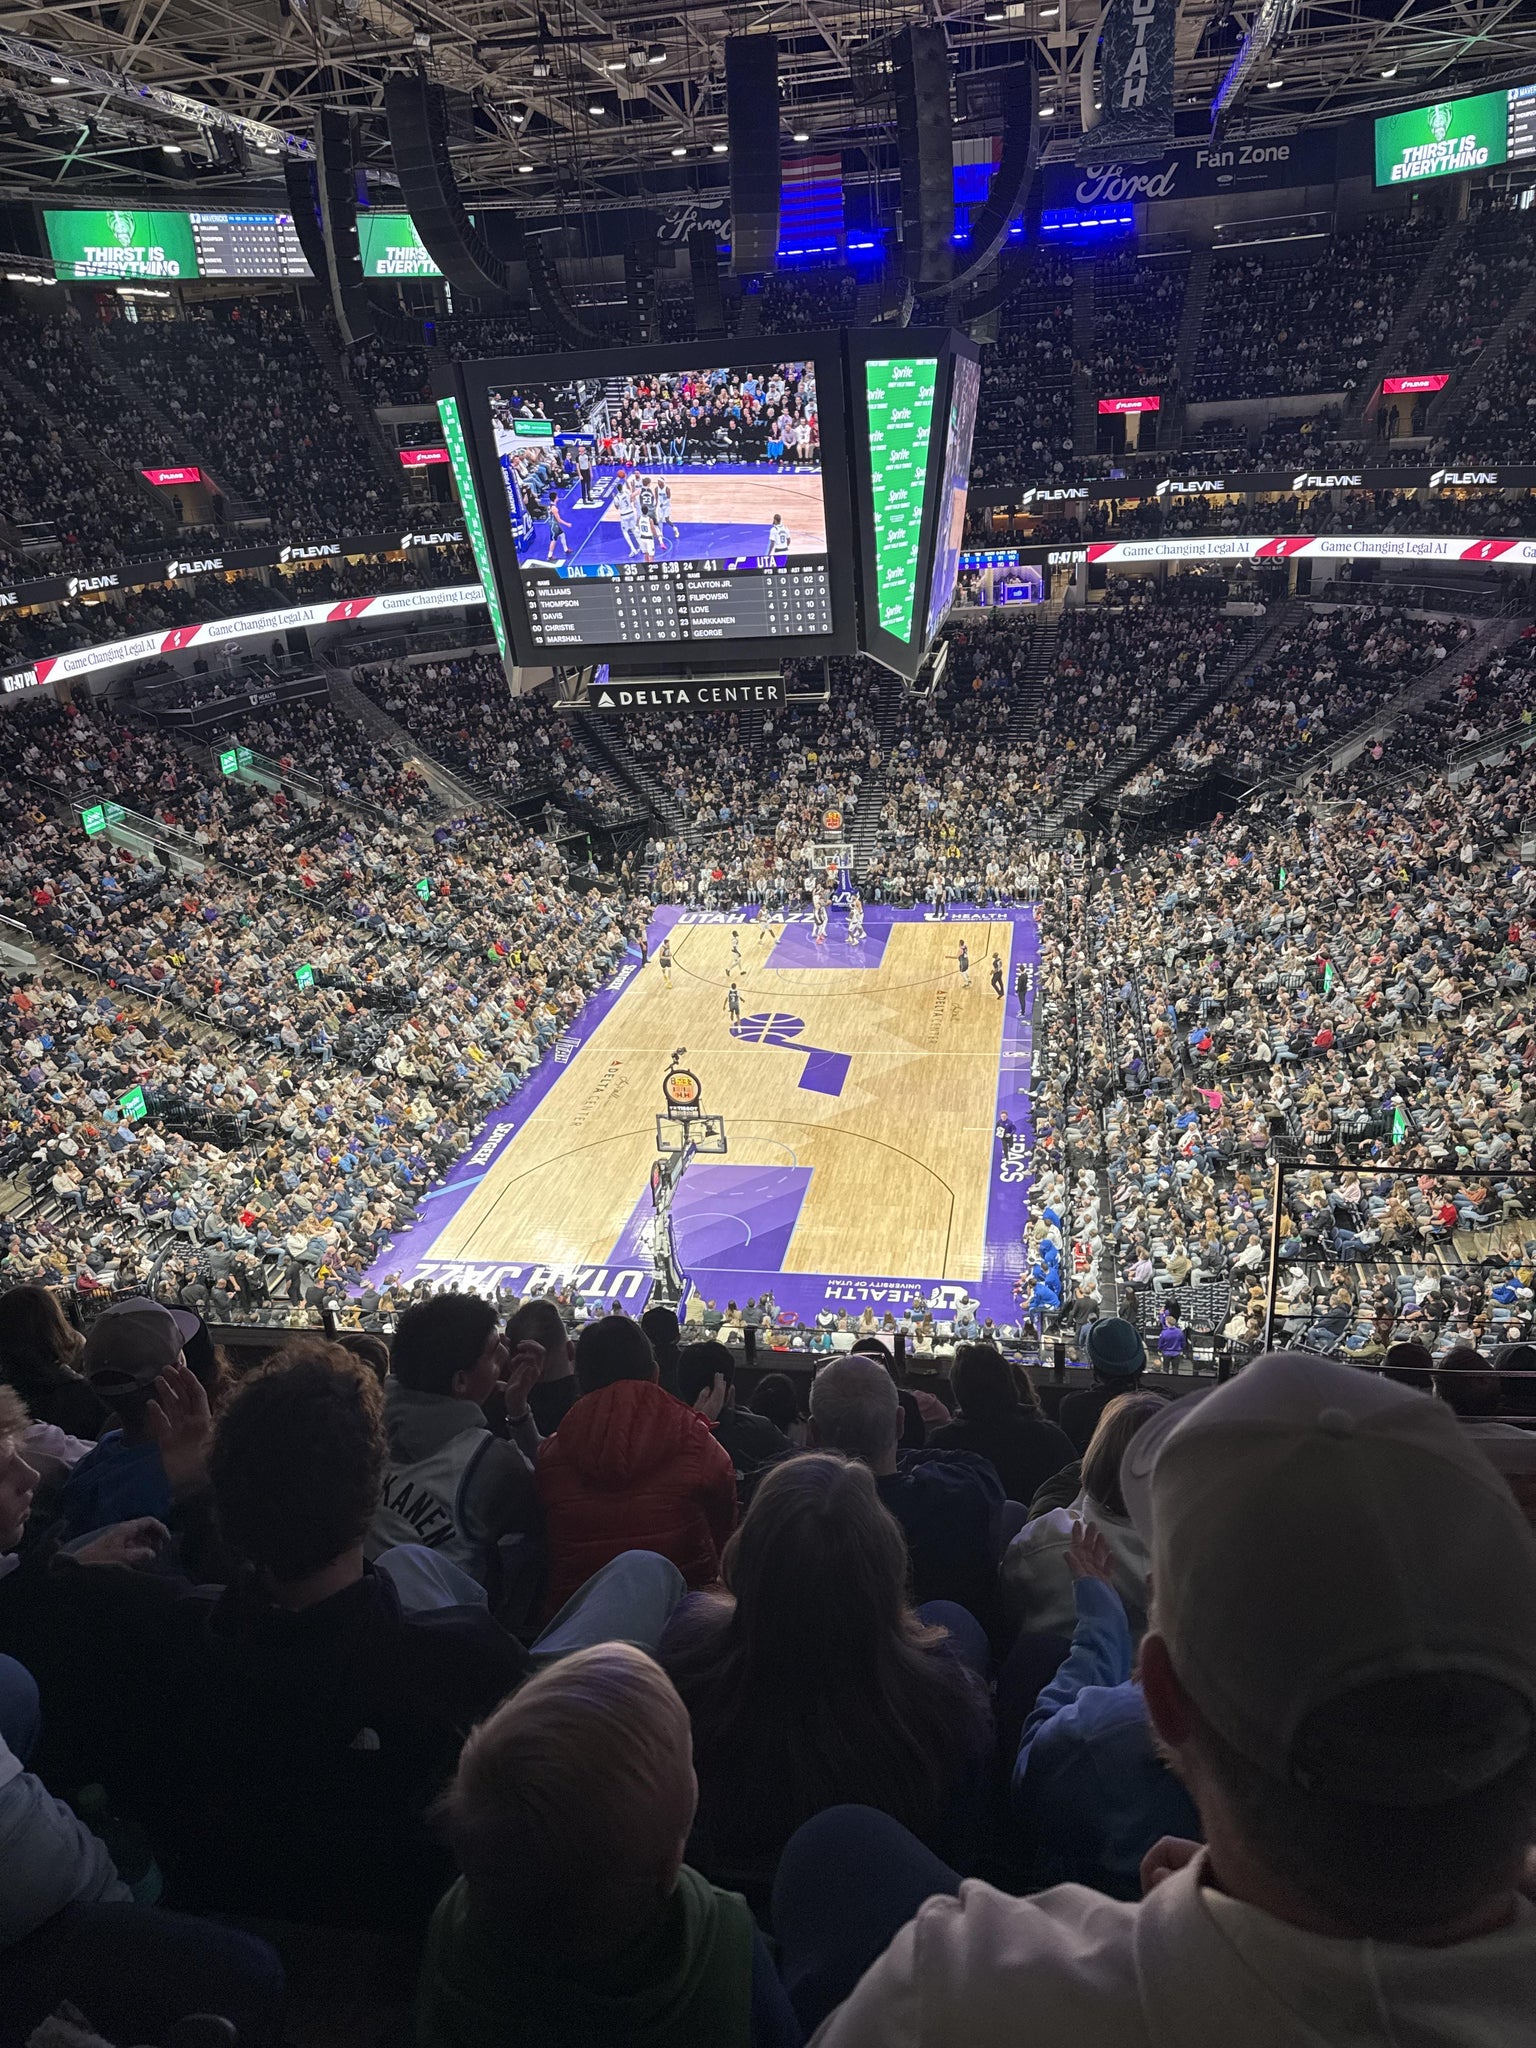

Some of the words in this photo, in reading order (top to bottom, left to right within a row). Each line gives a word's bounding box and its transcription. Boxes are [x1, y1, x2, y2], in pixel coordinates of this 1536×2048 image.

[1402, 138, 1458, 163] THIRST
[1460, 135, 1476, 150] IS
[1196, 150, 1233, 168] Fan
[1239, 146, 1290, 165] Zone
[1391, 147, 1488, 181] EVERYTHING
[1076, 161, 1179, 204] Ford
[84, 247, 145, 261] THIRST
[148, 247, 164, 261] IS
[386, 247, 428, 260] THIRS
[75, 261, 180, 276] EVERYTHING
[892, 366, 913, 380] Sprite
[890, 408, 912, 422] Sprite
[889, 449, 910, 463] Sprite
[1308, 475, 1362, 486] FILEVINE
[1444, 472, 1497, 485] FILEVINE
[1037, 488, 1089, 500] FILEVINE
[1170, 481, 1224, 493] FILEVINE
[888, 489, 908, 503] Sprite
[413, 532, 463, 545] FILEVINE
[887, 528, 906, 543] Sprite
[292, 544, 341, 559] FILEVINE
[1123, 546, 1154, 557] Game
[1156, 544, 1206, 558] Changing
[1208, 543, 1235, 554] Legal
[1237, 542, 1249, 552] AI
[1321, 542, 1352, 552] Game
[1354, 541, 1404, 554] Changing
[1406, 542, 1433, 554] Legal
[1435, 543, 1447, 554] AI
[1048, 552, 1070, 564] 07:47
[1073, 551, 1086, 563] PM
[178, 558, 224, 574] FILEVINE
[567, 566, 586, 577] DAL
[624, 564, 637, 575] 35
[662, 562, 679, 573] 6:38
[704, 560, 717, 571] 41
[757, 557, 776, 568] UTA
[79, 574, 119, 591] FILEVINE
[688, 581, 720, 589] CLAYTON
[383, 598, 410, 609] Game
[412, 593, 457, 607] Changing
[459, 589, 484, 602] Legal
[209, 624, 233, 637] Game
[234, 617, 277, 632] Changing
[278, 613, 301, 627] Legal
[302, 610, 314, 620] AI
[64, 656, 86, 672] Game
[88, 649, 124, 666] Changing
[125, 642, 144, 658] Legal
[144, 639, 155, 650] AI
[3, 673, 24, 692] 07:47
[25, 670, 38, 687] PM
[620, 689, 690, 705] DELTA
[698, 686, 778, 702] CENTER
[678, 913, 746, 923] UTAH
[593, 1068, 619, 1093] DELTA
[570, 1095, 600, 1126] CENTER
[466, 1122, 514, 1165] SEATGEEK
[825, 1287, 920, 1303] HEALTH
